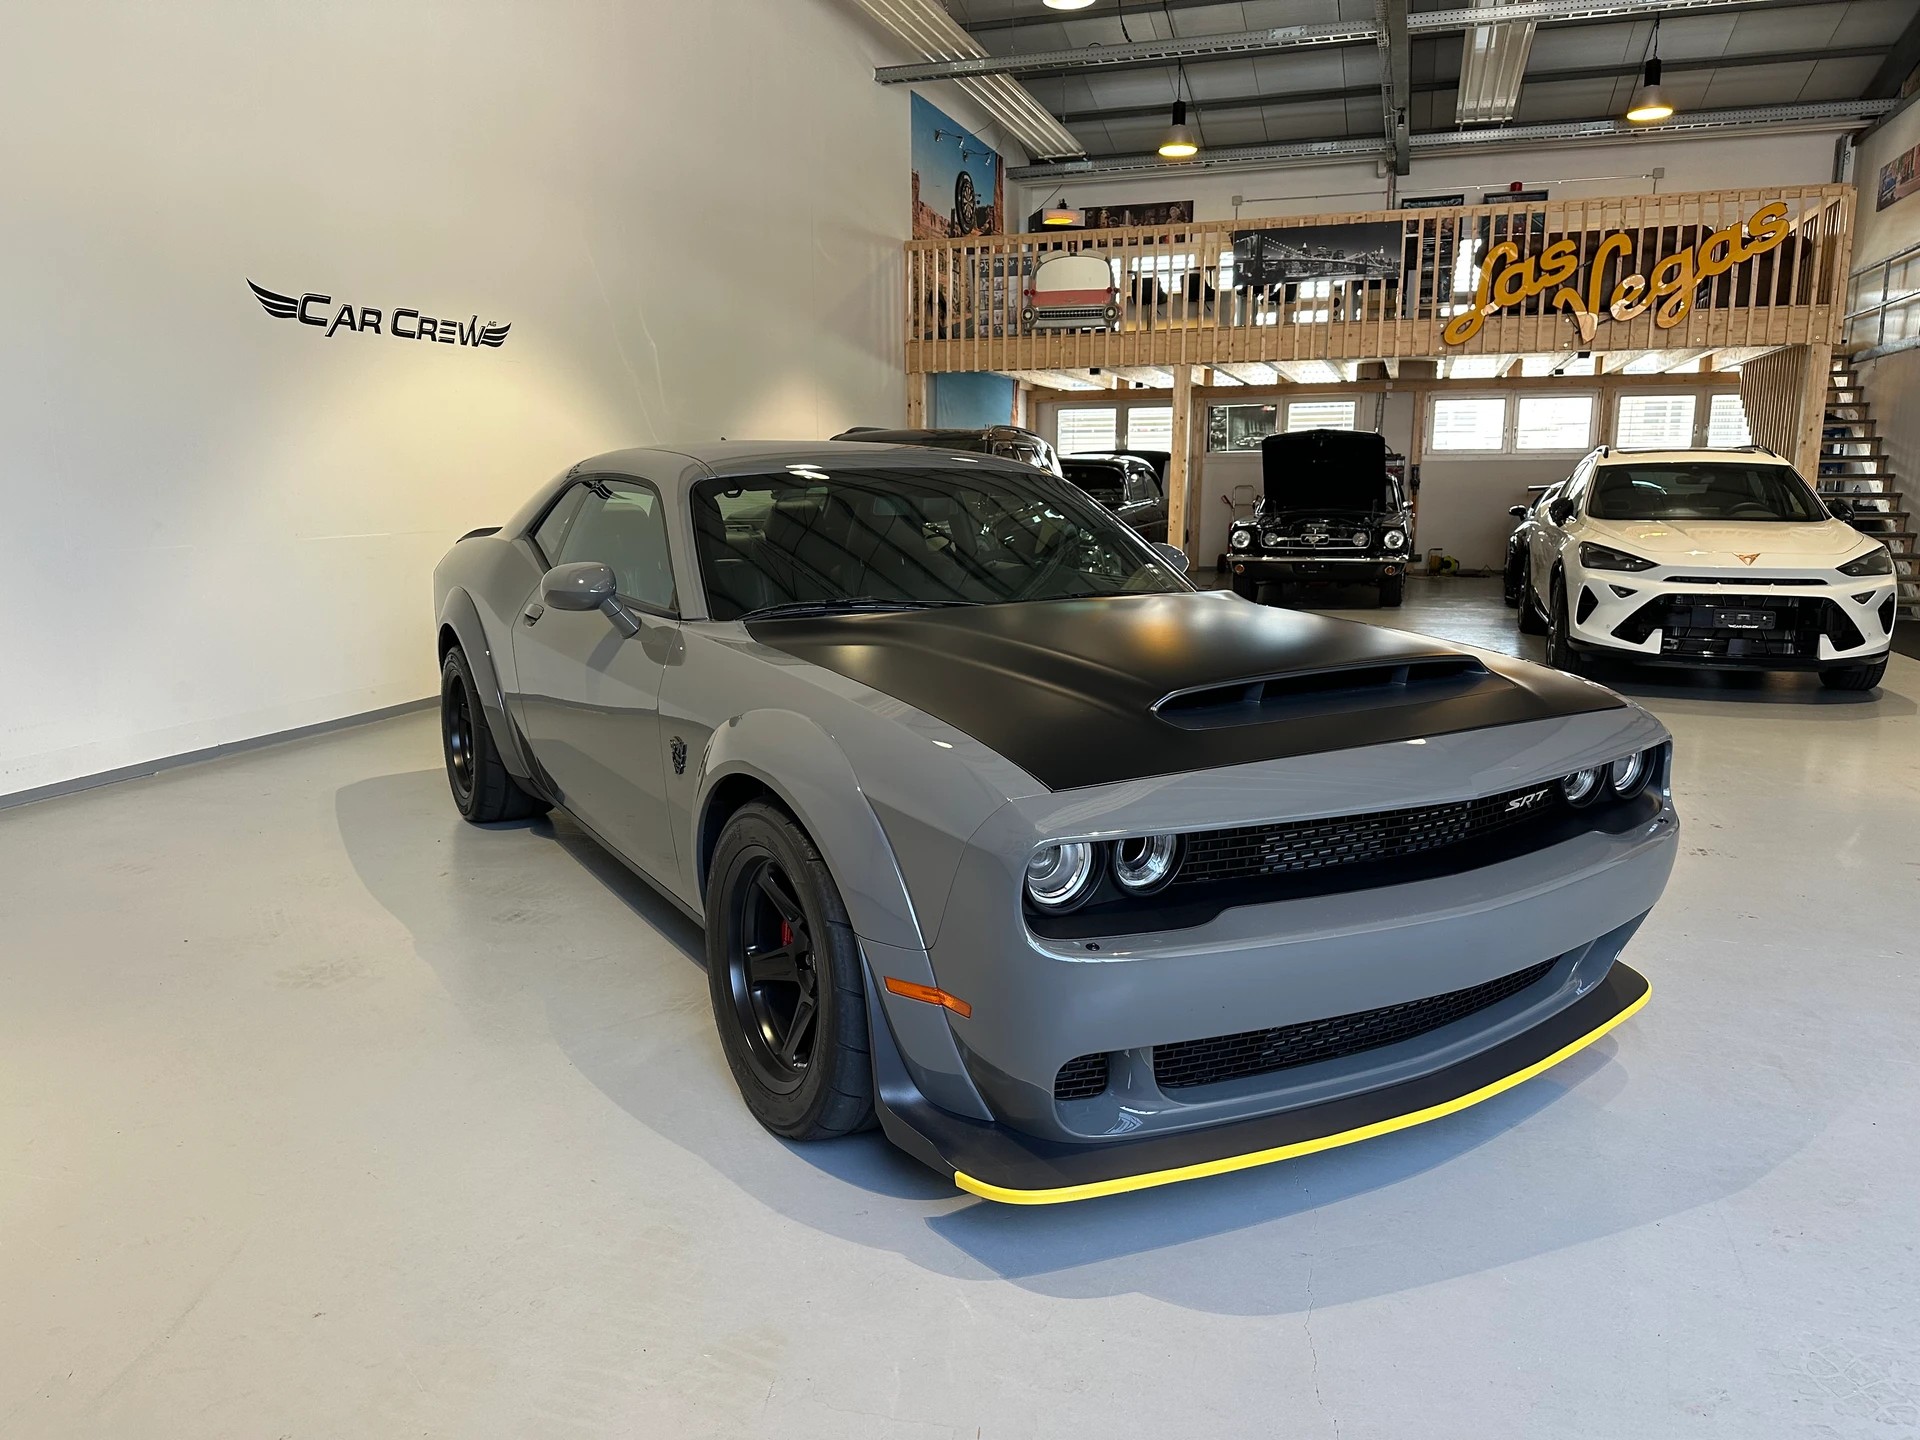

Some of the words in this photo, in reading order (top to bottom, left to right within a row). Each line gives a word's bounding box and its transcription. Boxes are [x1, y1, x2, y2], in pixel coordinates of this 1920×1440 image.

[1442, 237, 1578, 346] Las
[1552, 201, 1791, 345] Vegas
[1504, 788, 1549, 812] SRT
